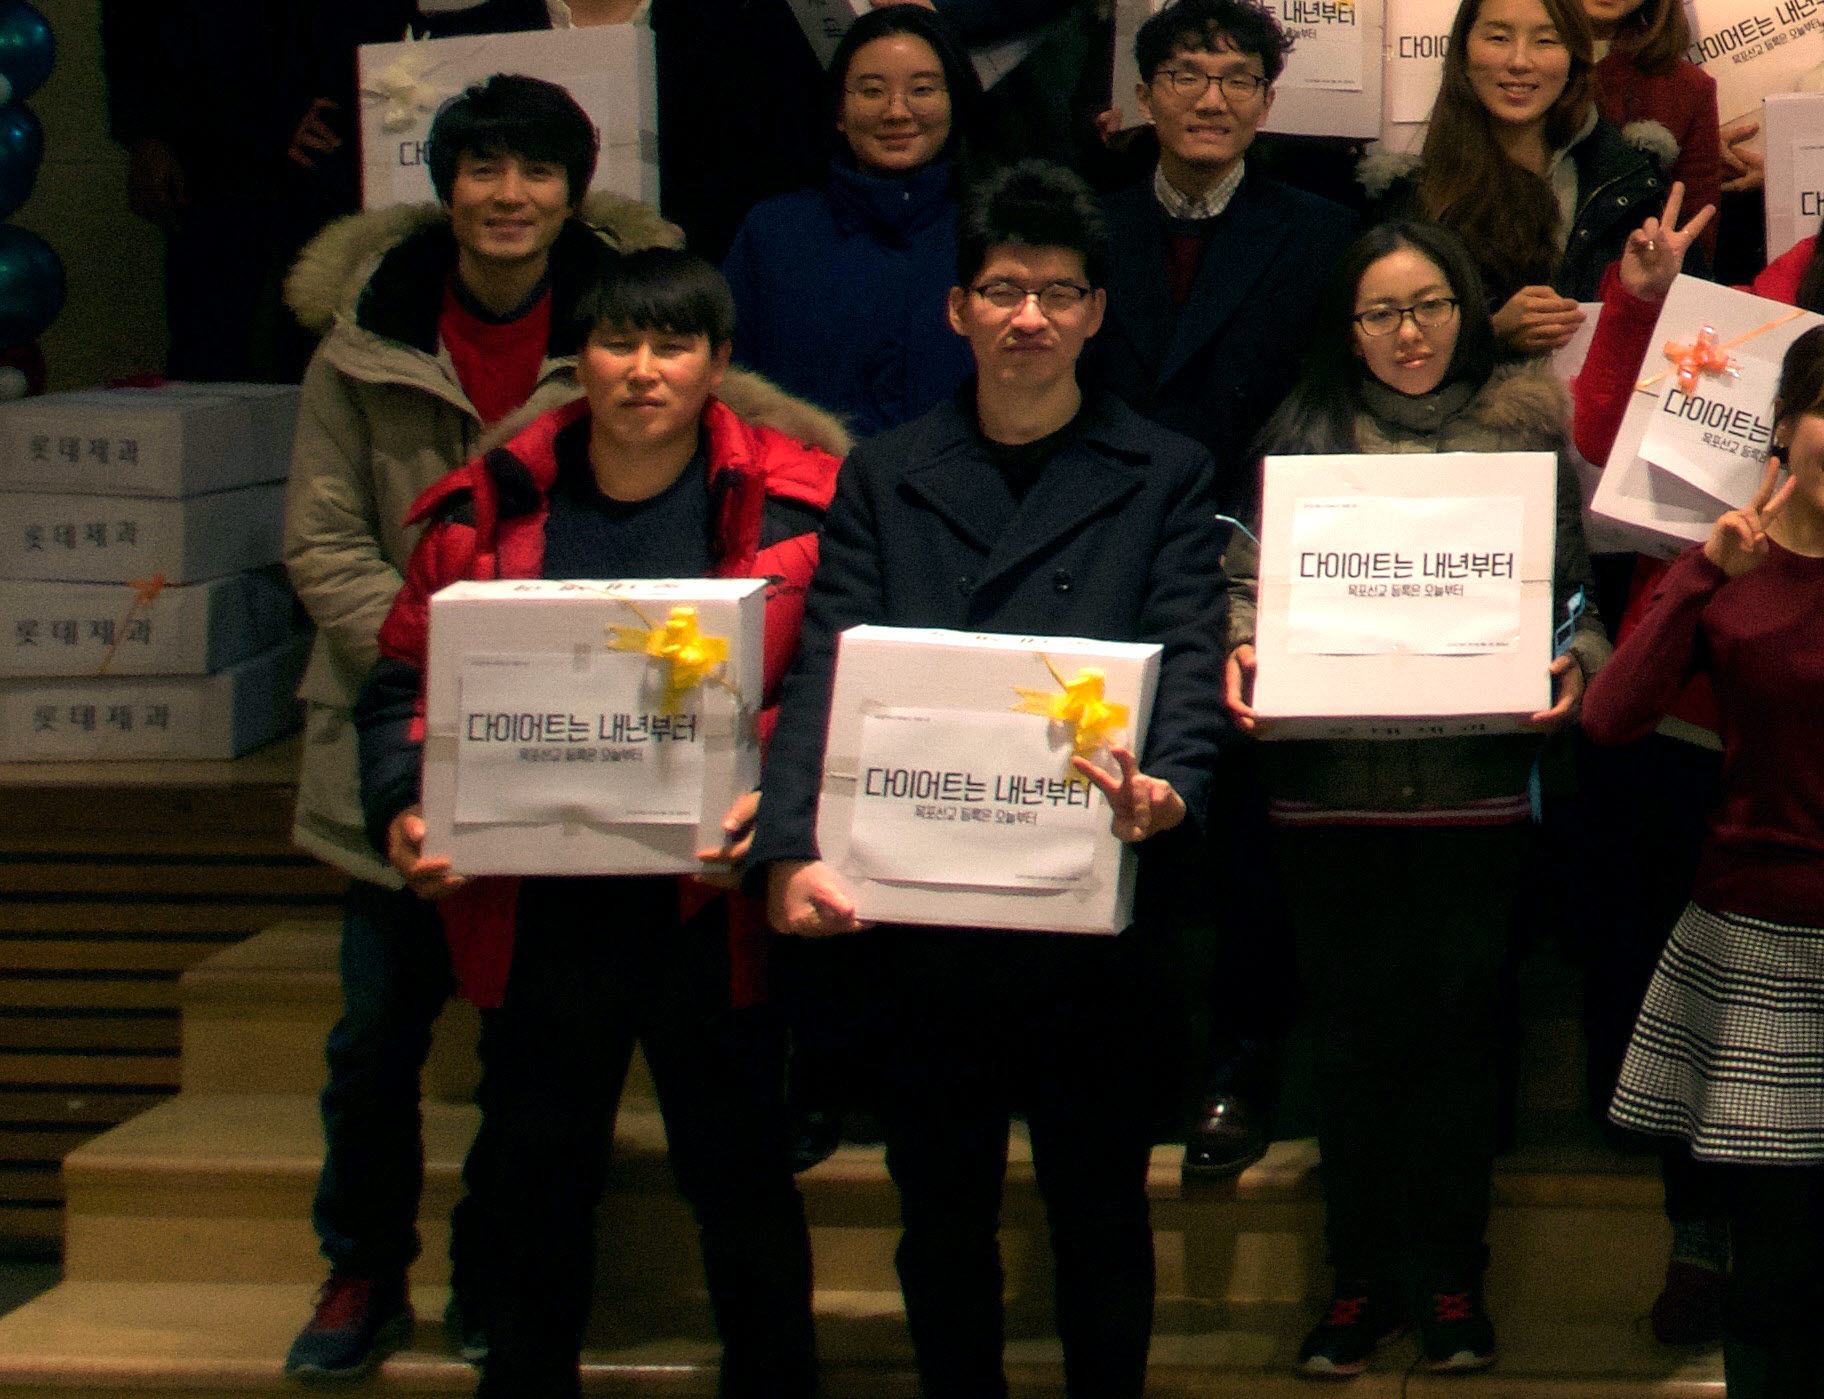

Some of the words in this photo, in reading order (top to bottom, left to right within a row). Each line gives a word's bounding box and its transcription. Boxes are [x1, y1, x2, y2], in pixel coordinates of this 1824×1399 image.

[1284, 0, 1355, 26] 내년부터
[1688, 15, 1775, 66] 다이어트는
[1732, 47, 1765, 64] 목포선교
[1766, 32, 1789, 52] 등록은
[1790, 18, 1822, 41] 오늘부터
[1664, 388, 1772, 444] 다이어트는
[1701, 432, 1740, 453] 목포선교
[1300, 553, 1413, 579] 다이어트는
[1423, 553, 1514, 579] 내년부터
[1349, 584, 1387, 597] 목포선교
[1392, 584, 1420, 597] 등록은
[1425, 584, 1464, 597] 오늘부터
[468, 713, 590, 742] 다이어트는
[599, 714, 697, 742] 내년부터
[866, 768, 987, 802] 다이어트는
[995, 776, 1092, 808] 내년부터
[914, 804, 957, 820] 목포선교
[996, 808, 1037, 825] 오늘부터
